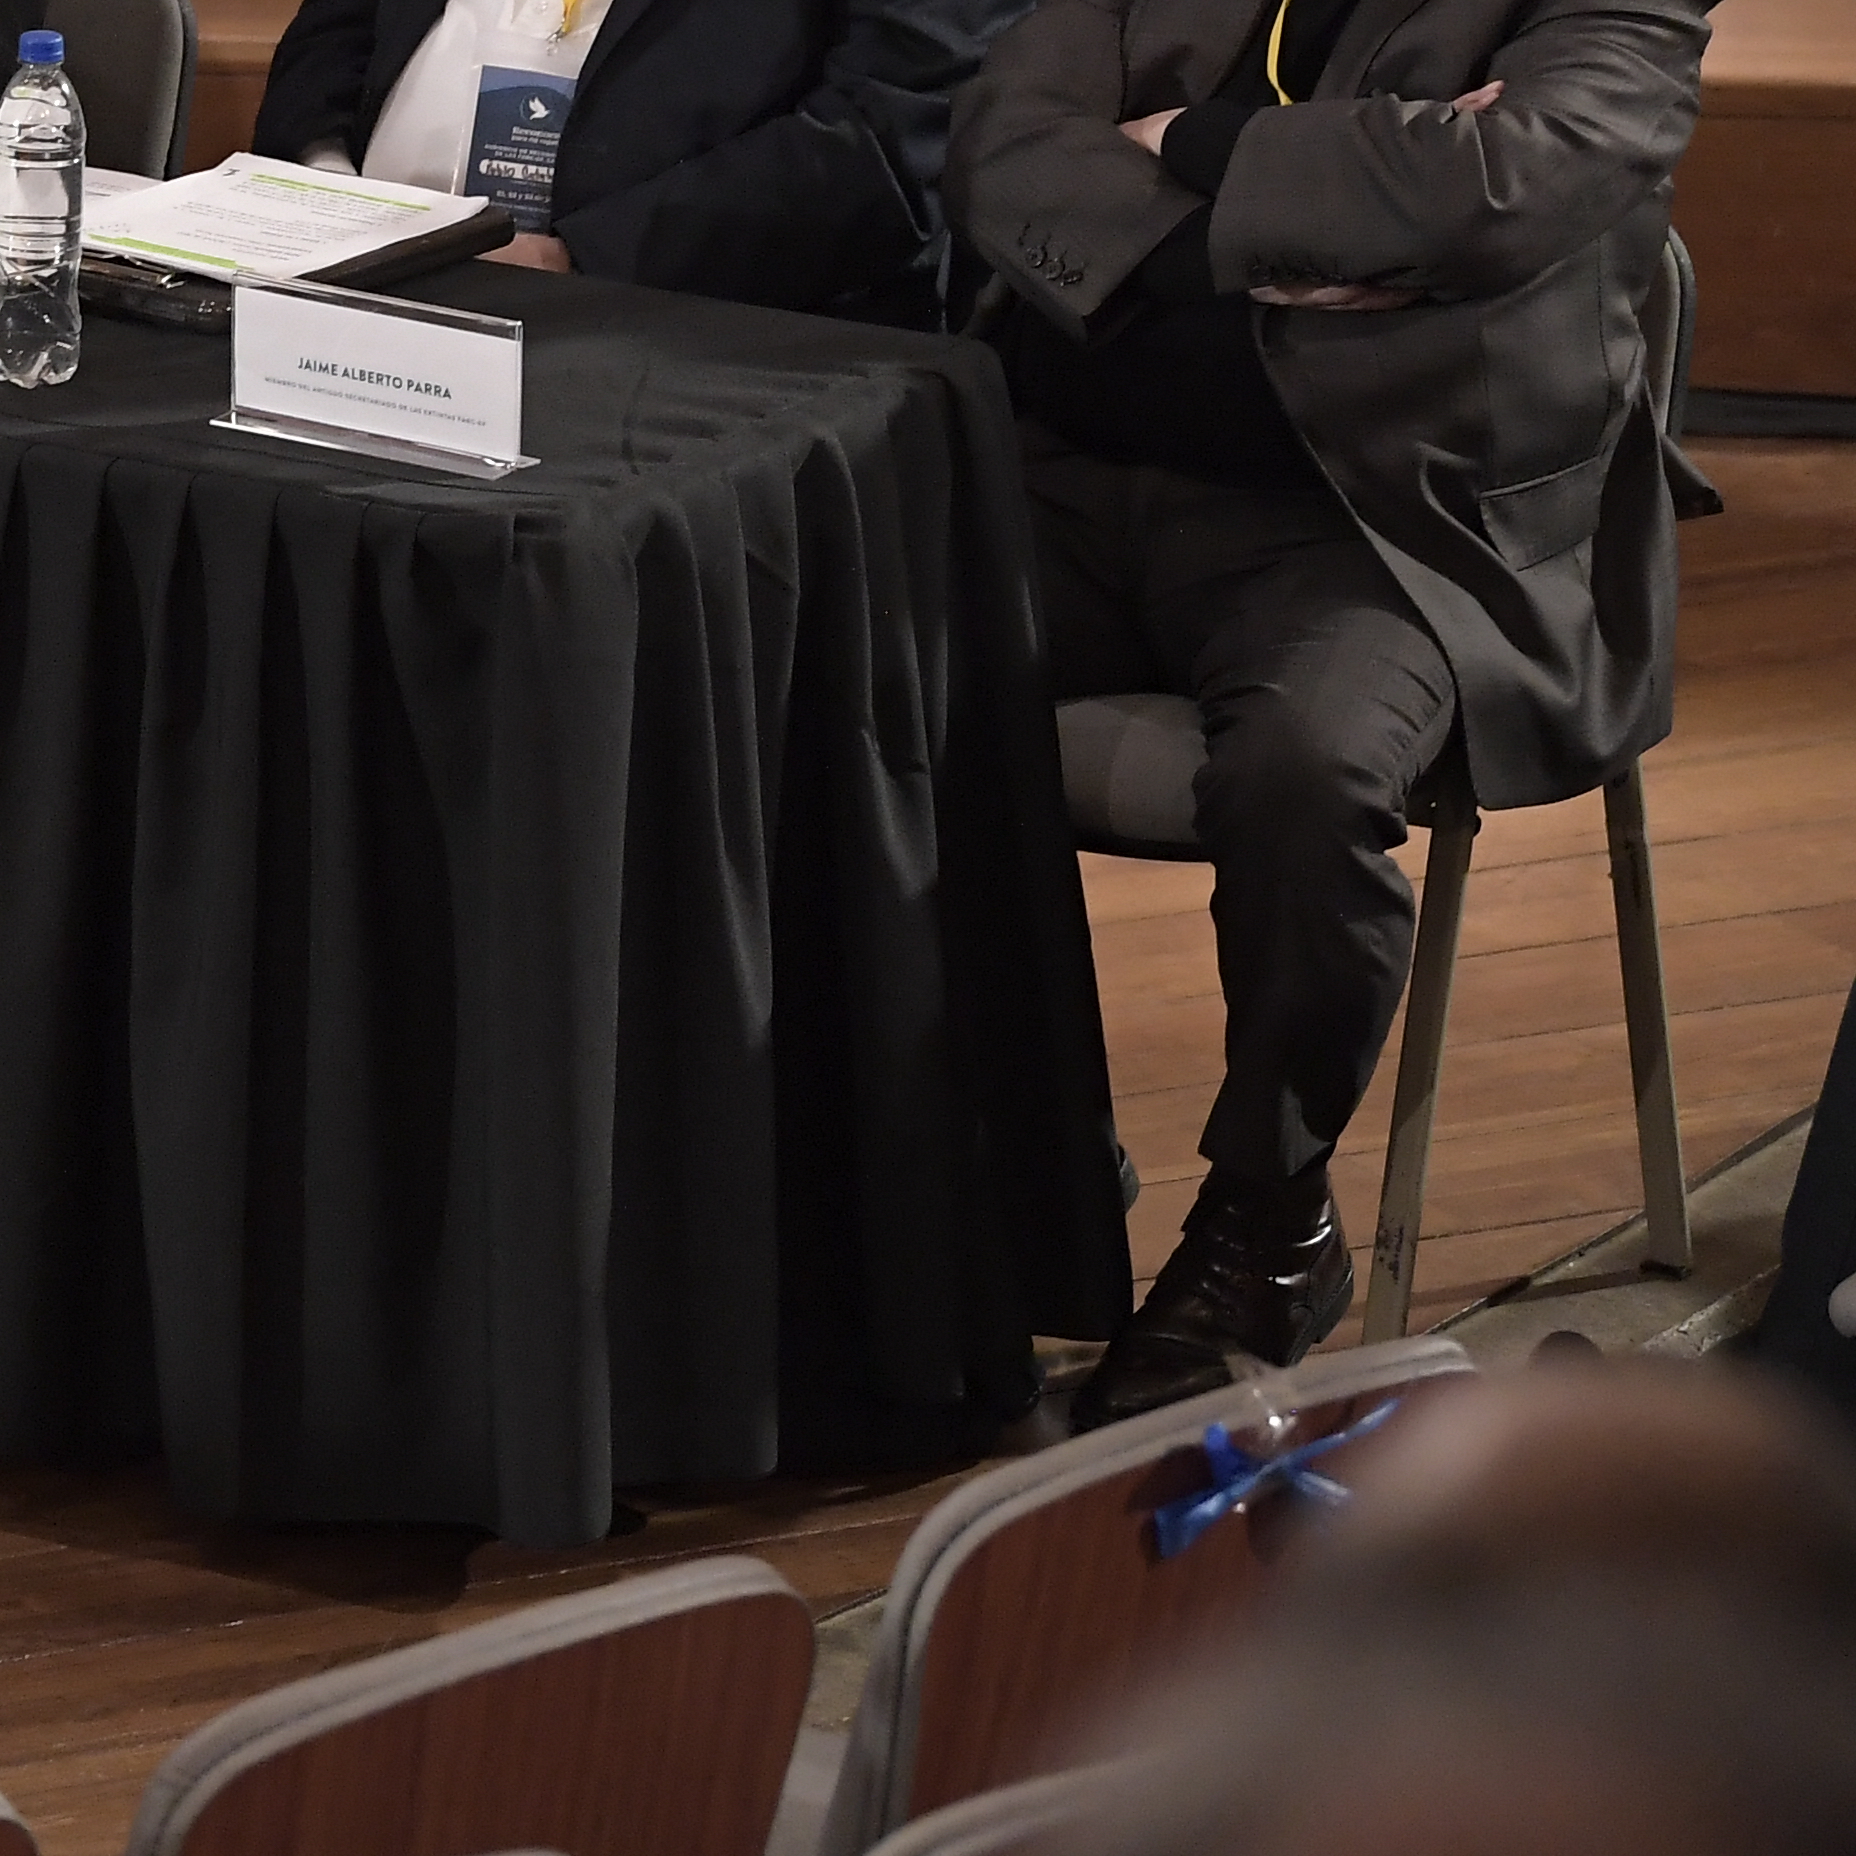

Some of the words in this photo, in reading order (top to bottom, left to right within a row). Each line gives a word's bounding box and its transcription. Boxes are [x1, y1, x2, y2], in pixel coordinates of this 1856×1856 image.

[297, 358, 338, 376] JAIME
[341, 367, 403, 389] ALBERTO
[406, 379, 452, 399] PARRA
